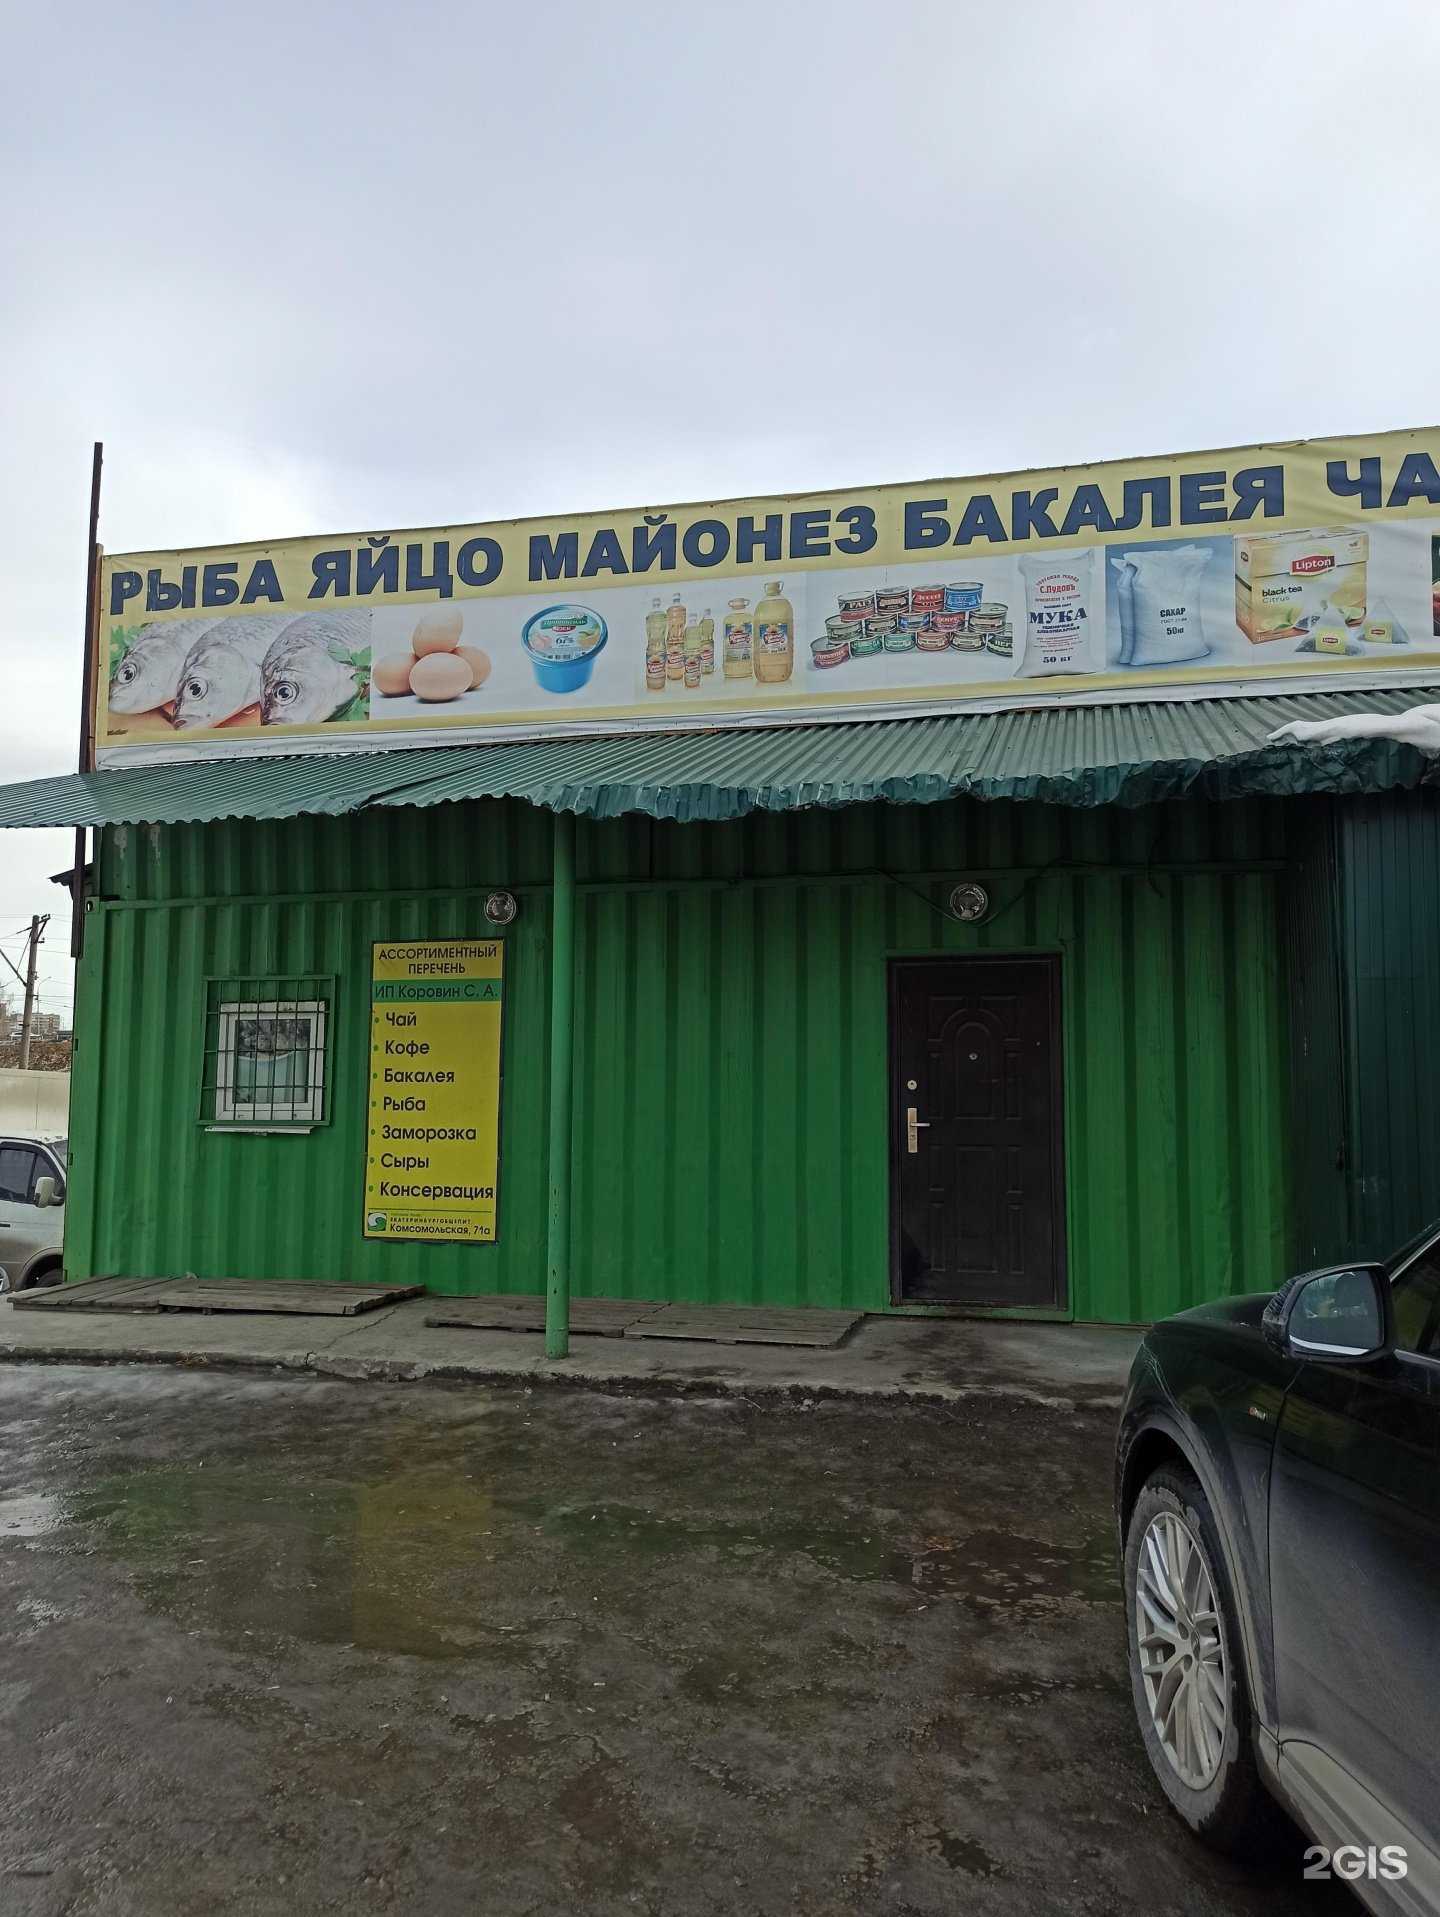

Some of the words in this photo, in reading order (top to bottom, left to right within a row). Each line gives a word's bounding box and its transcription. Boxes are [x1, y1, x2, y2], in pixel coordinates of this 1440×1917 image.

[110, 560, 284, 615] РЫБА
[308, 536, 503, 599] ЯЙЦО
[529, 505, 878, 582] МАЙОНЕЗ
[904, 465, 1284, 551] БАКАЛЕЯ
[1295, 557, 1332, 572] Lipton
[1262, 586, 1287, 597] black
[1288, 585, 1303, 593] tea
[1029, 607, 1088, 625] МУКА
[1160, 607, 1186, 618] САХАР
[1043, 656, 1057, 664] 50
[378, 944, 498, 961] АССОРТИМЕНТНЫЙ
[408, 962, 467, 976] ПЕРЕЧЕНЬ
[375, 984, 395, 999] ИП
[399, 984, 461, 1001] Коровин
[385, 1011, 418, 1027] Чай
[385, 1039, 430, 1058] Кофе
[384, 1067, 455, 1084] Бакалея
[383, 1096, 426, 1112] Рыба
[382, 1124, 477, 1143] Заморозка
[380, 1152, 430, 1172] Сыры
[380, 1181, 494, 1201] Консервация
[390, 1223, 471, 1236] Комсомольская,
